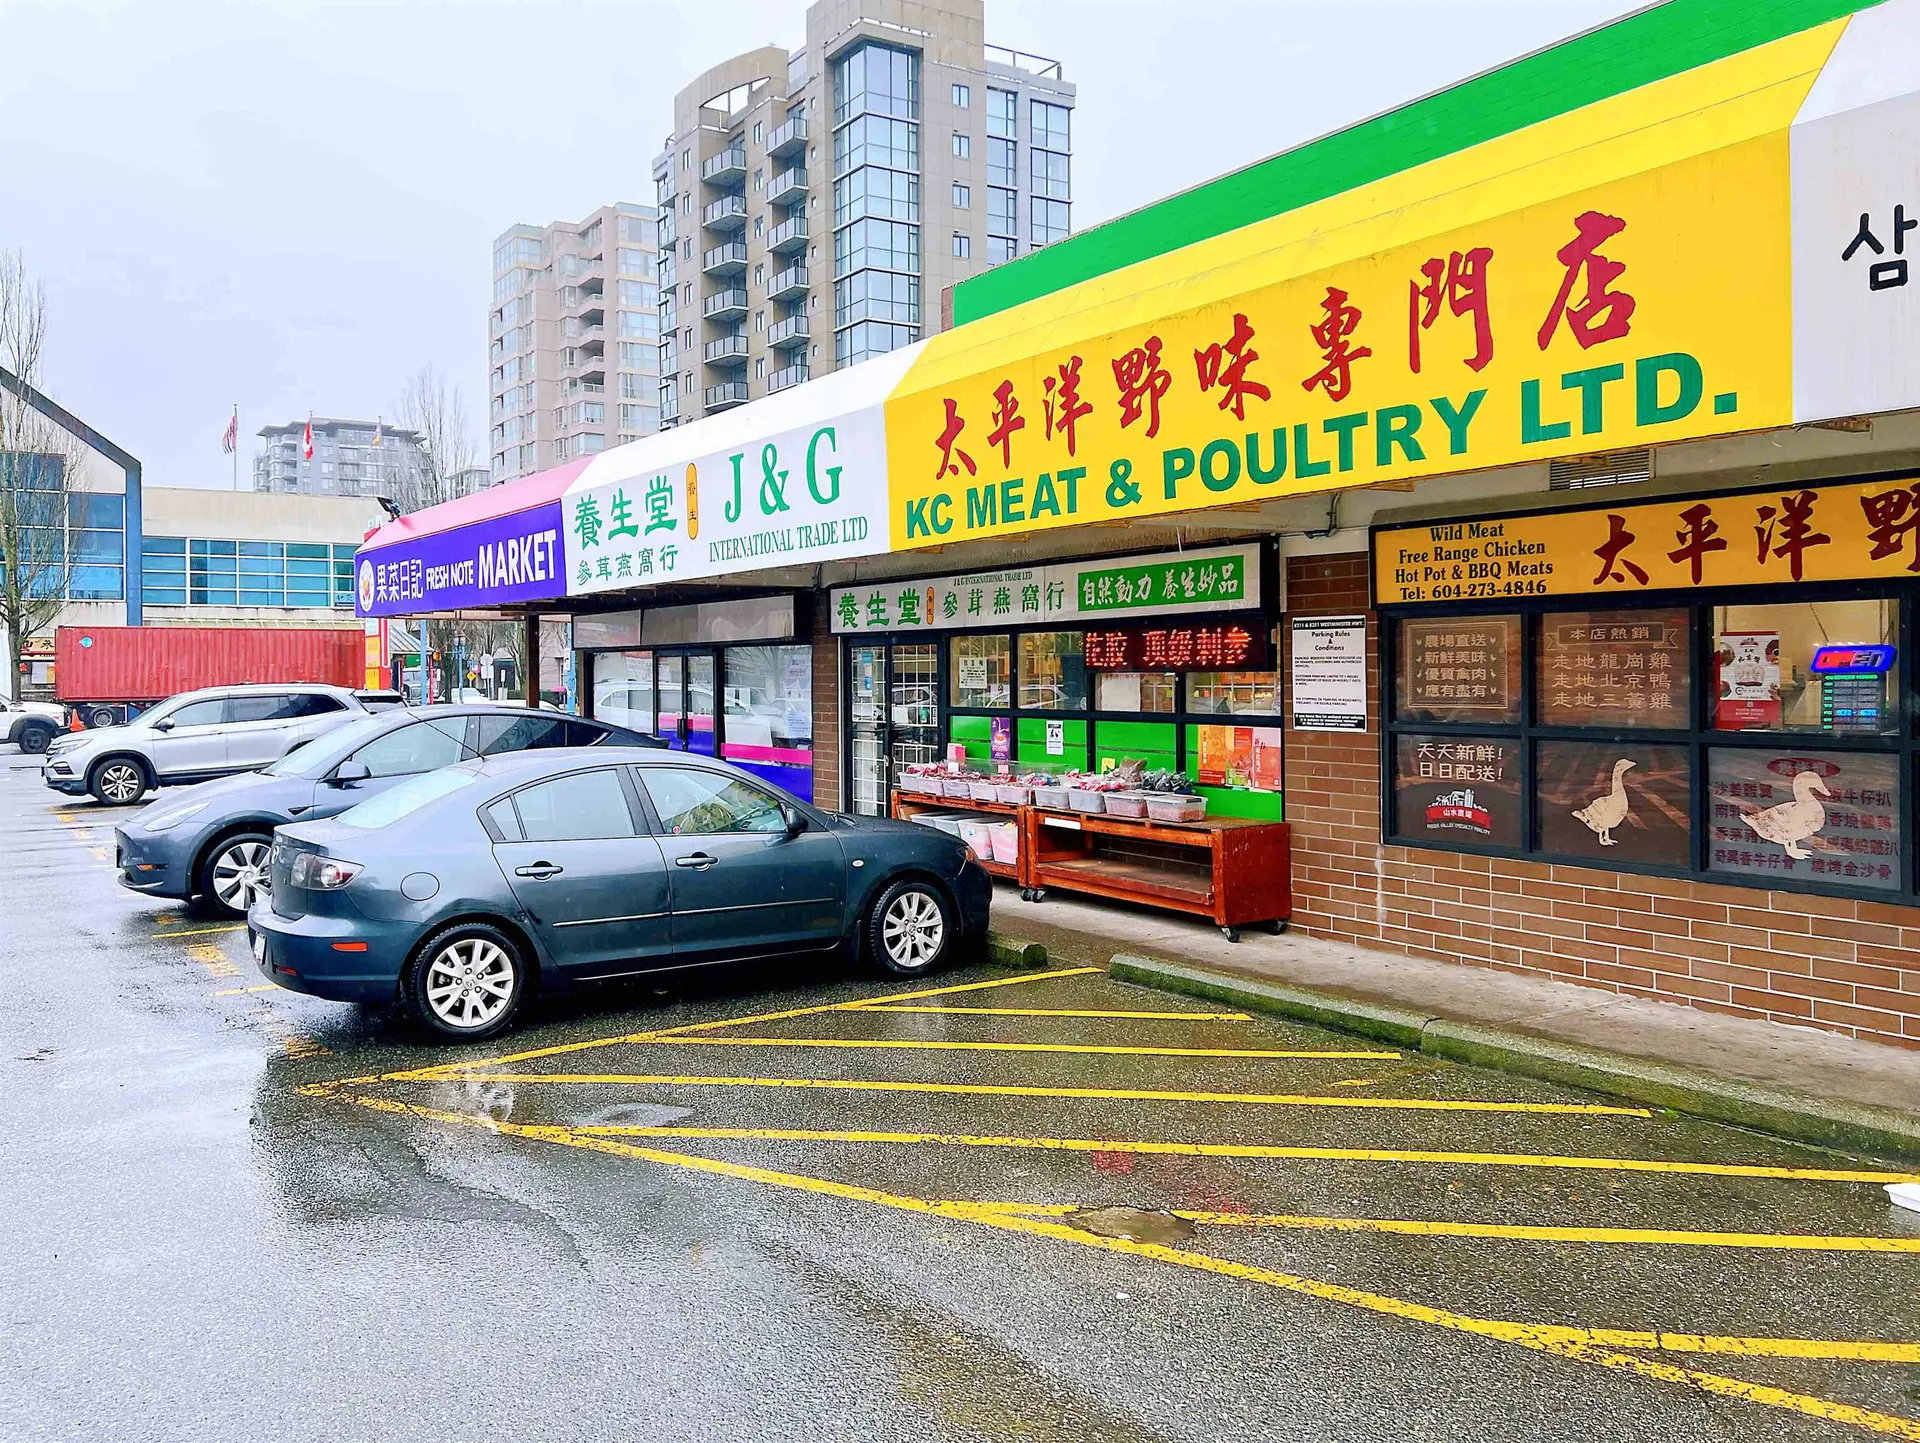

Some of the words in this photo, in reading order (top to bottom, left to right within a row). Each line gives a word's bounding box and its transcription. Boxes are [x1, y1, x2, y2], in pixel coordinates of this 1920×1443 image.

[906, 493, 953, 538] KC
[966, 466, 1087, 529] MEAT
[1105, 458, 1141, 507] &
[1163, 388, 1488, 500] POULTRY
[1521, 352, 1737, 445] LTD.
[724, 453, 744, 523] J
[759, 443, 790, 516] &
[806, 427, 843, 504] G
[573, 475, 678, 549] 養生堂
[709, 528, 794, 562] INTERNATIONAL
[797, 520, 838, 549] TRADE
[842, 516, 868, 543] LTD
[1430, 525, 1463, 542] Wild
[1468, 522, 1504, 539] Meat
[1399, 549, 1428, 564] Free
[1434, 546, 1478, 562] Range
[1484, 539, 1545, 557] Chicken
[377, 558, 423, 602] 果菜日記
[426, 566, 449, 590] FRESH
[450, 560, 474, 587] NOTE
[478, 529, 556, 590] MARKET
[576, 544, 679, 586] 參茸燕窩行
[1395, 568, 1419, 583] Hot
[1424, 566, 1446, 581] Pot
[1452, 564, 1463, 580] &
[1468, 562, 1501, 580] BBQ
[1507, 560, 1553, 576] Meats
[943, 581, 1065, 619] 參茸燕窩行
[1083, 573, 1152, 606] 自然動力
[1400, 586, 1426, 600] Tel:
[1432, 579, 1547, 599] 604-273-4846
[837, 588, 921, 628] 養生堂
[1311, 630, 1333, 638] Parking
[1335, 629, 1350, 637] Rules
[1425, 634, 1487, 647] 農場直送
[1570, 627, 1649, 640] 本店熱銷
[1424, 651, 1487, 664] 新鮮美味
[1552, 652, 1672, 669] 走地龍崗雞
[1425, 684, 1487, 697] 應有盡有
[1552, 672, 1672, 689] 走地北京鴨
[1418, 742, 1503, 762] 天天新鮮!
[1419, 762, 1503, 783] 日日配送!
